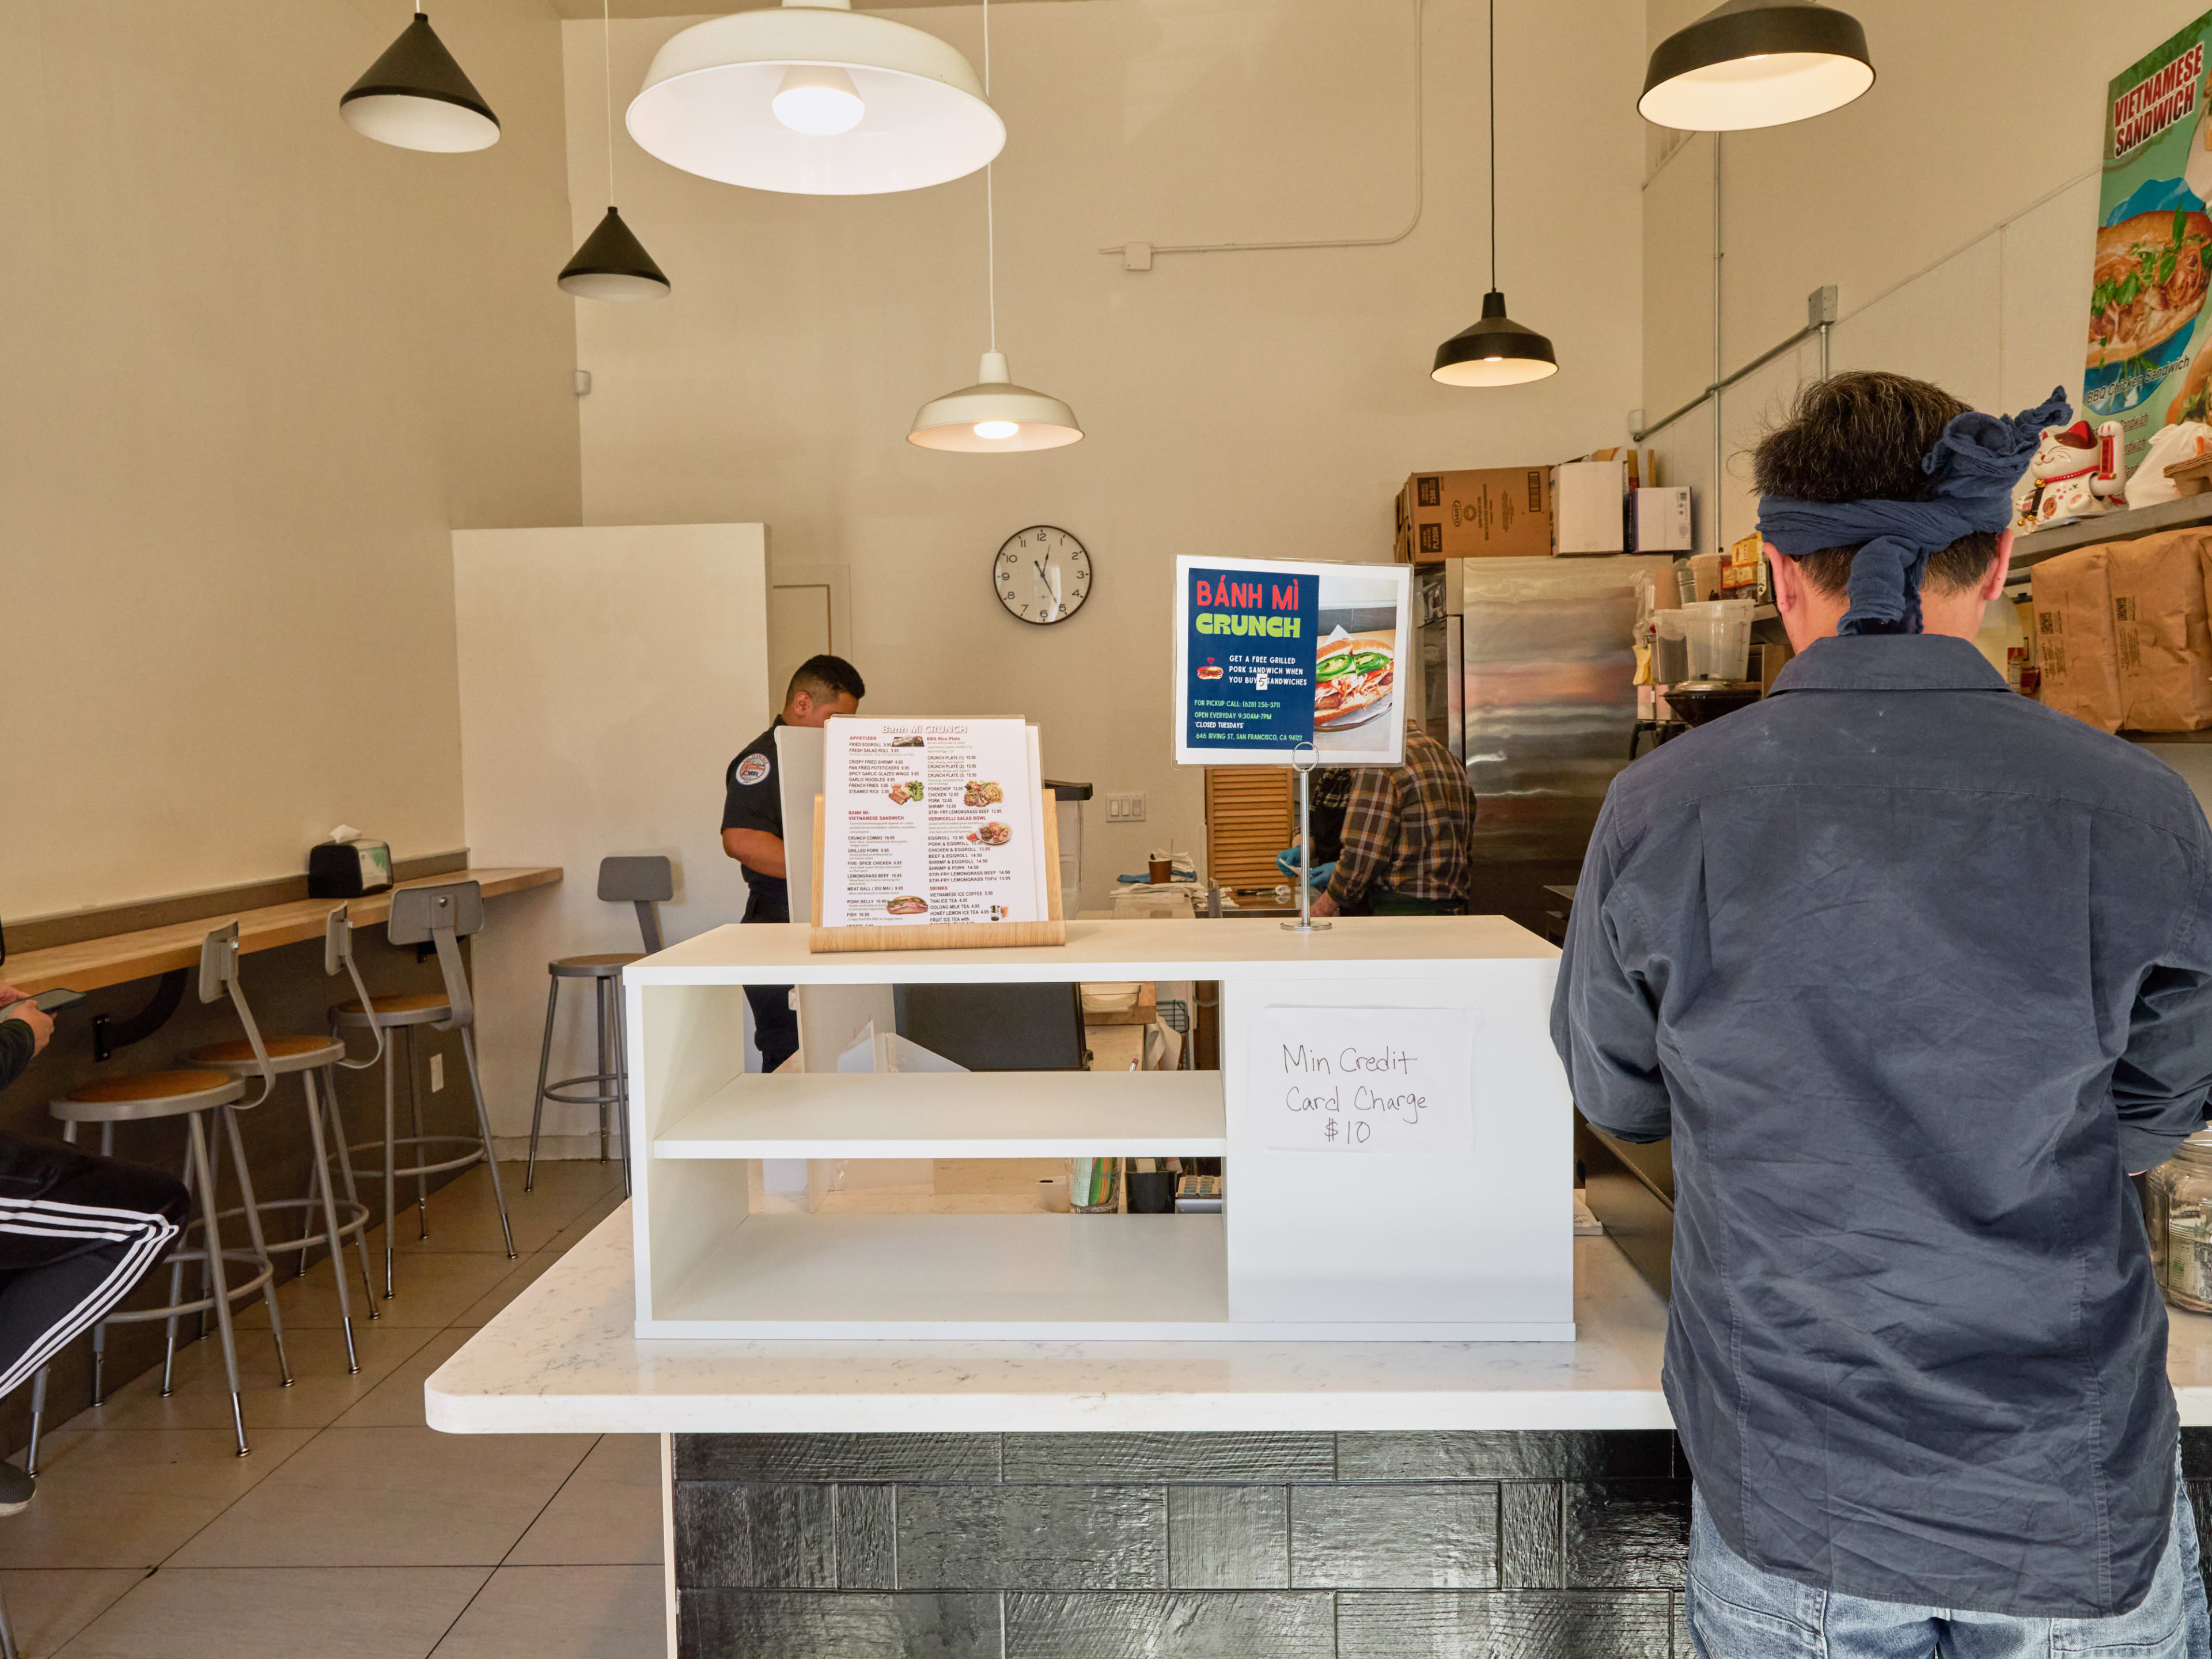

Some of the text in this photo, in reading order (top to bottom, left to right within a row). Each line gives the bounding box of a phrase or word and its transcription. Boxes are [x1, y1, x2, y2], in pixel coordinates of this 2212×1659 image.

[2114, 43, 2203, 128] VIETNAMESE
[2115, 80, 2196, 158] SANDWICH
[2087, 356, 2190, 404] BBQ Chicken Sandwich
[1021, 539, 1026, 547] 11
[1006, 555, 1017, 563] 10
[1002, 573, 1010, 581] 9
[1077, 571, 1084, 579] 3
[1197, 575, 1298, 611] BÁNH MÌ
[1196, 613, 1301, 638] CRUNCH
[1259, 677, 1267, 687] 5
[881, 725, 908, 733] Banh
[925, 725, 968, 733] CRUNCH
[1283, 1044, 1418, 1074] Min Credit
[1286, 1085, 1428, 1124] Card Charge
[1324, 1118, 1370, 1144] $10
